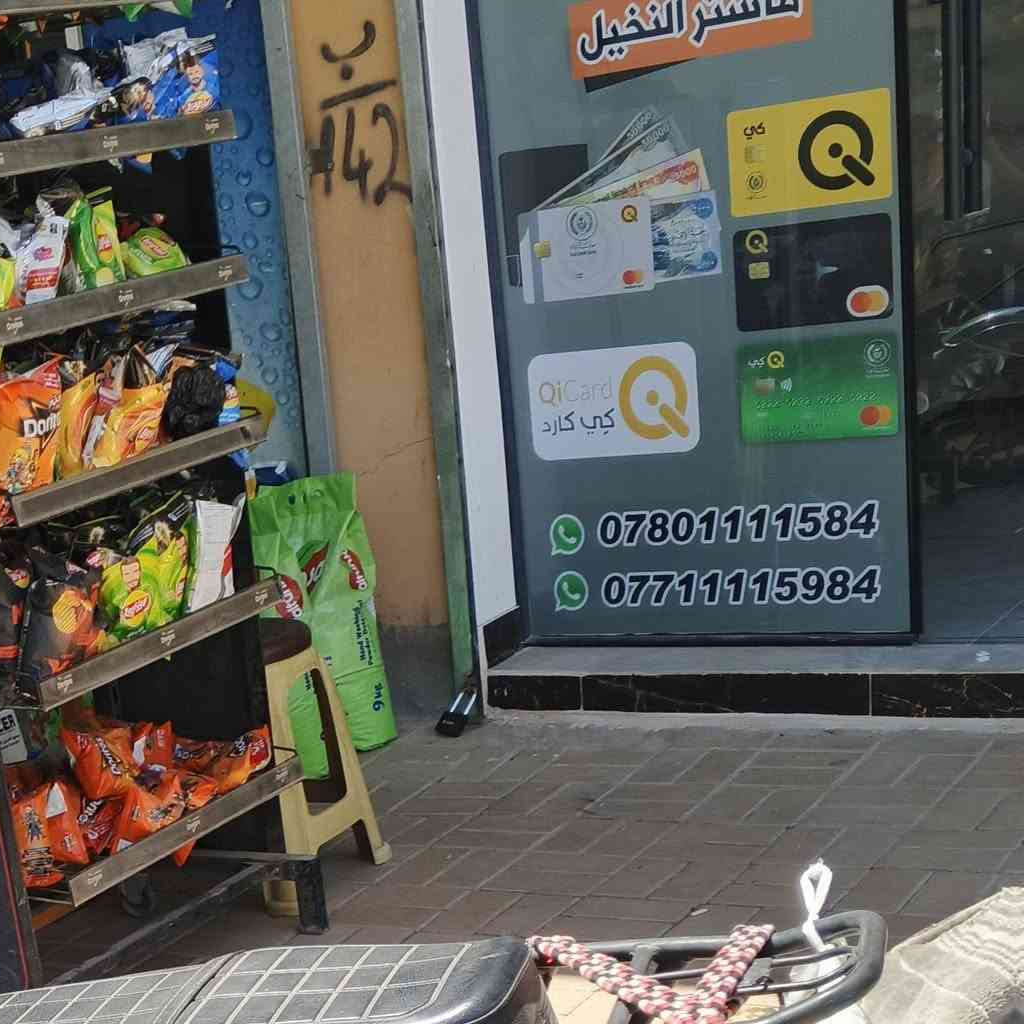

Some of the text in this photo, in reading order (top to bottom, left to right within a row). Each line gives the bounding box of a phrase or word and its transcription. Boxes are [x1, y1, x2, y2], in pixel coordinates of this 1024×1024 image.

[577, 0, 688, 65] النخيل
[541, 410, 576, 436] كارد
[597, 499, 880, 549] 07801111584
[601, 565, 881, 608] 07711115984
